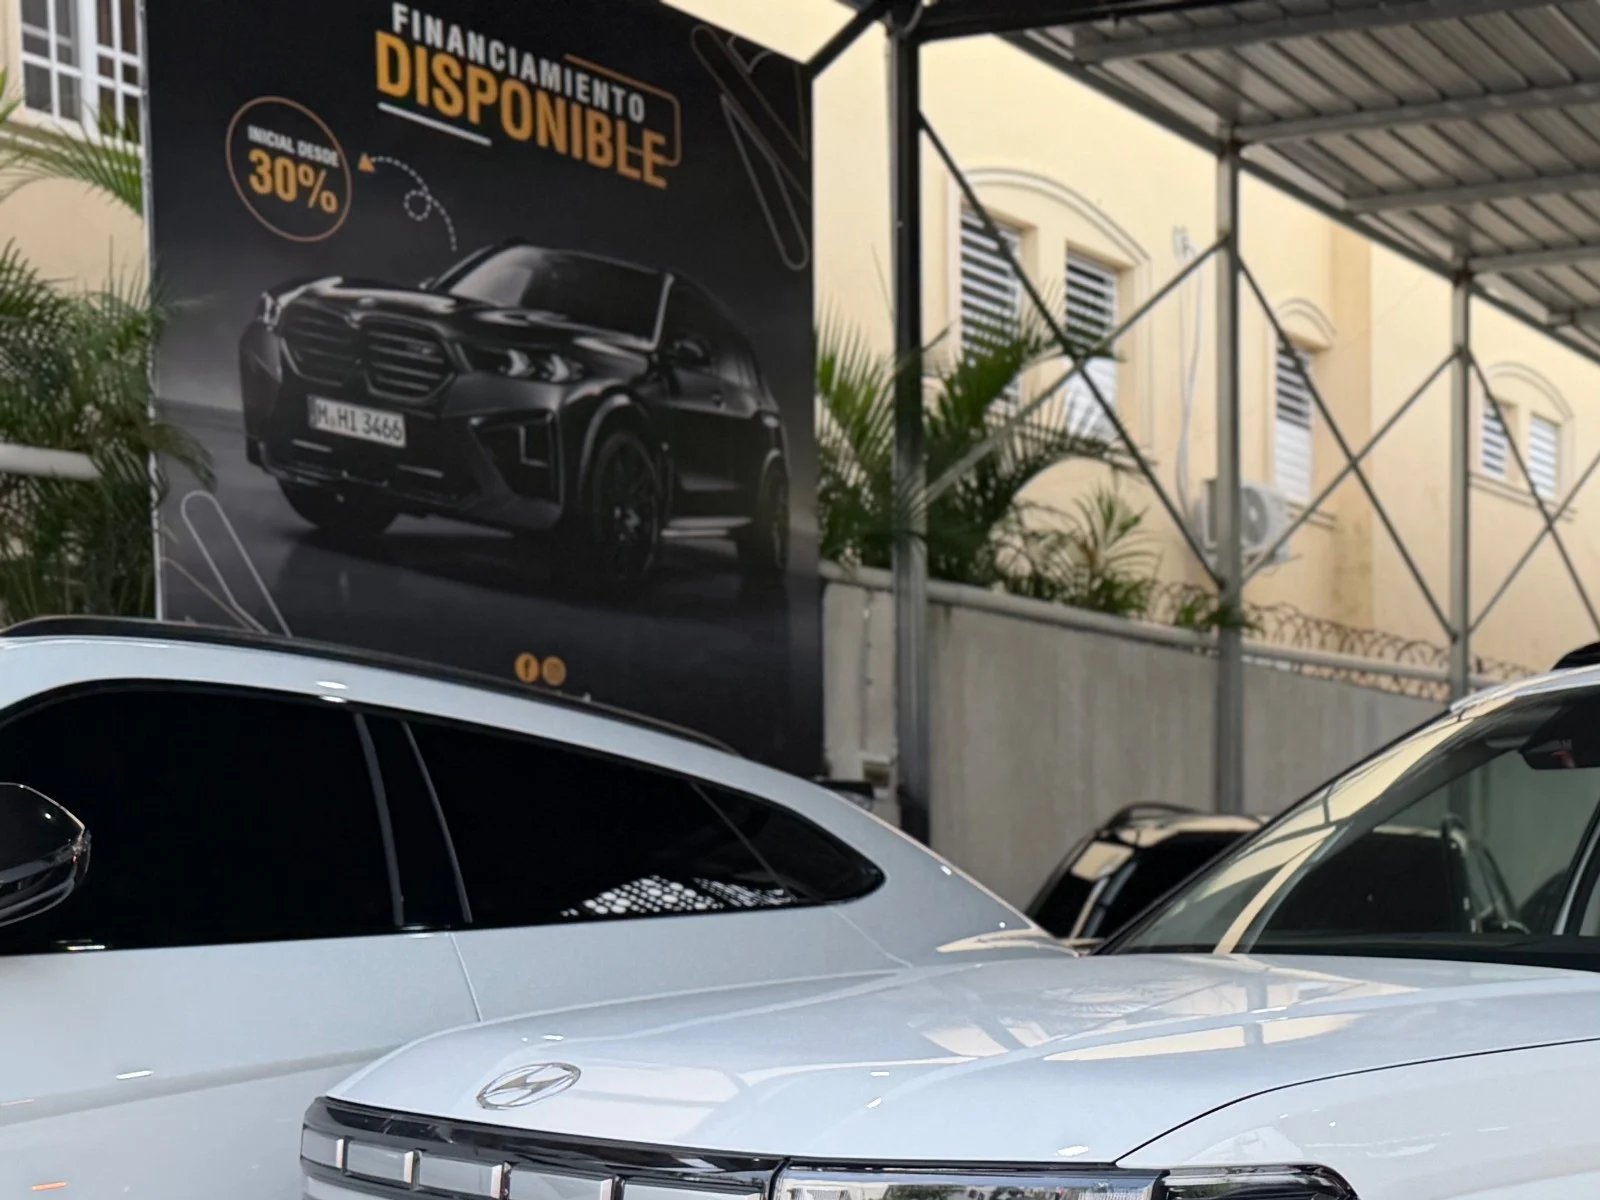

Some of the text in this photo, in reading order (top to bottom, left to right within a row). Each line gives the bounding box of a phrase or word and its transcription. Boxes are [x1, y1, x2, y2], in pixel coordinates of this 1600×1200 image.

[392, 2, 645, 123] FINANCIAMIENTO
[247, 124, 339, 168] INICIAL DESDE
[376, 30, 667, 189] DISPONIBLE
[248, 148, 338, 214] 30%
